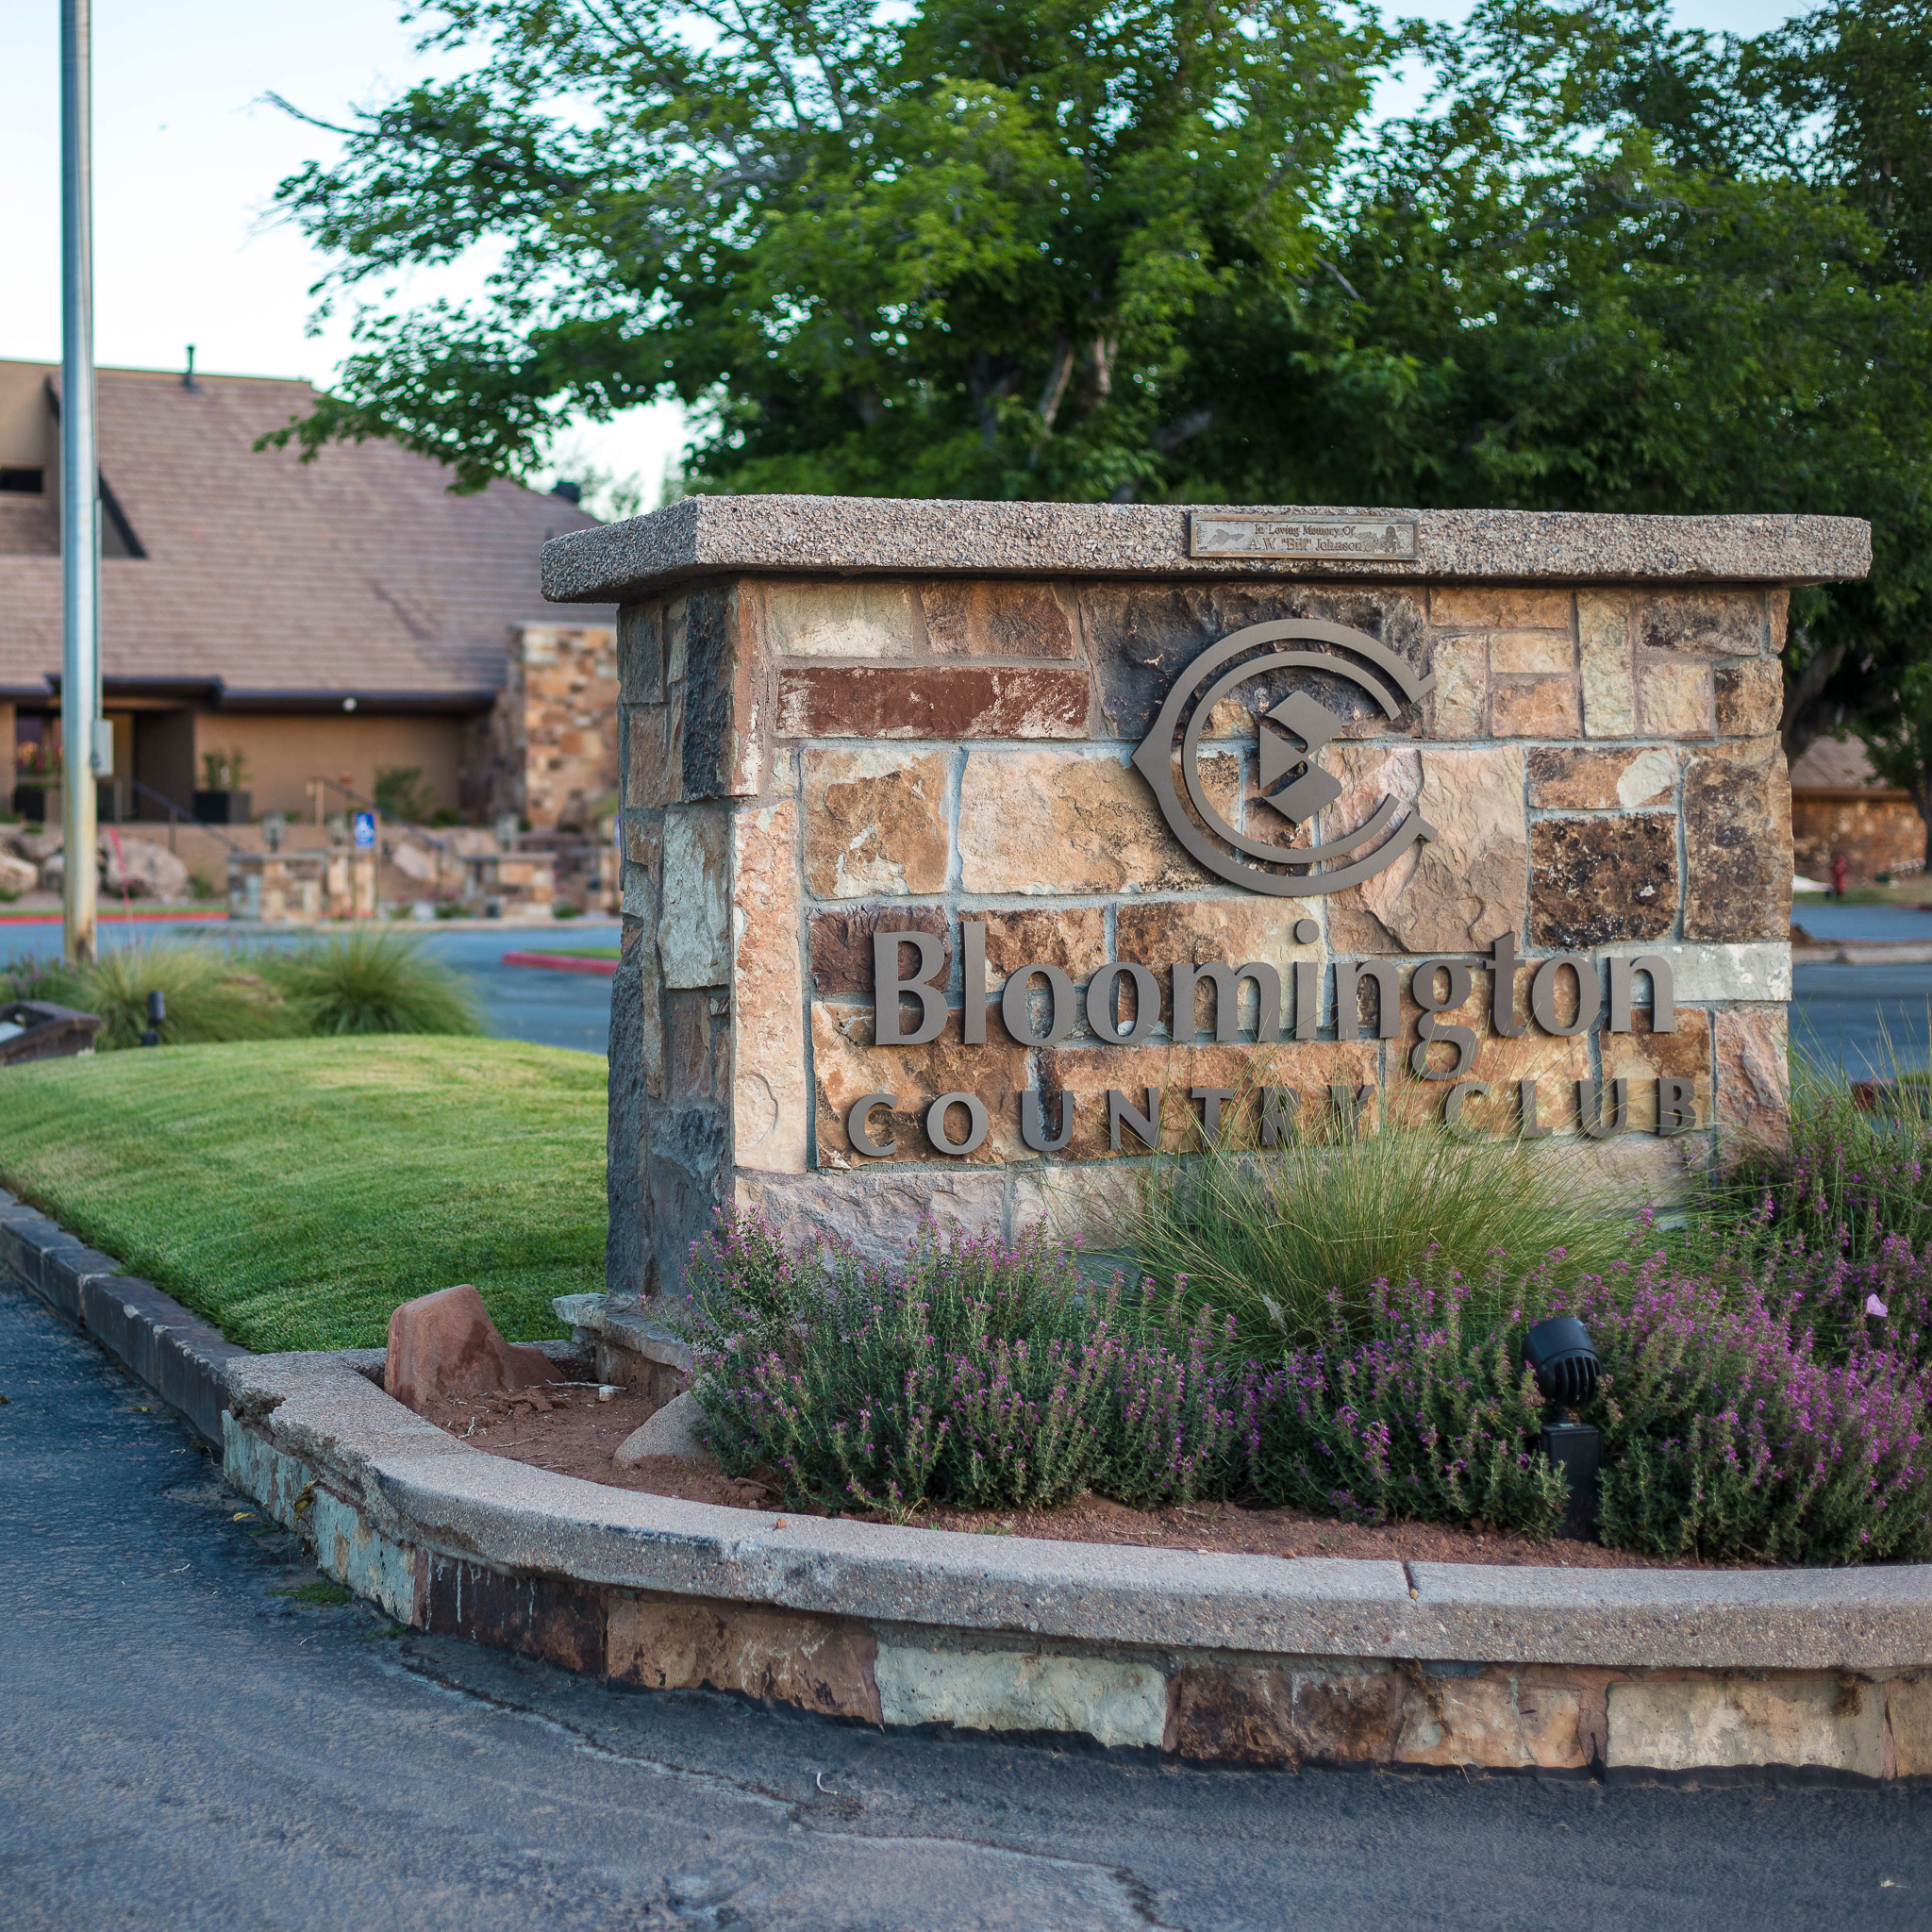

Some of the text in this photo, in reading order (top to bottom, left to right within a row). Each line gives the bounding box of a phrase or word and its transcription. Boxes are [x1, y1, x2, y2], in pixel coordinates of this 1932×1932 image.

[1255, 524, 1356, 538] In Loving Memory Of
[1316, 539, 1362, 552] Johnson
[872, 918, 1675, 1080] Bloomington
[847, 1075, 1699, 1158] COUNTRY CLUB
